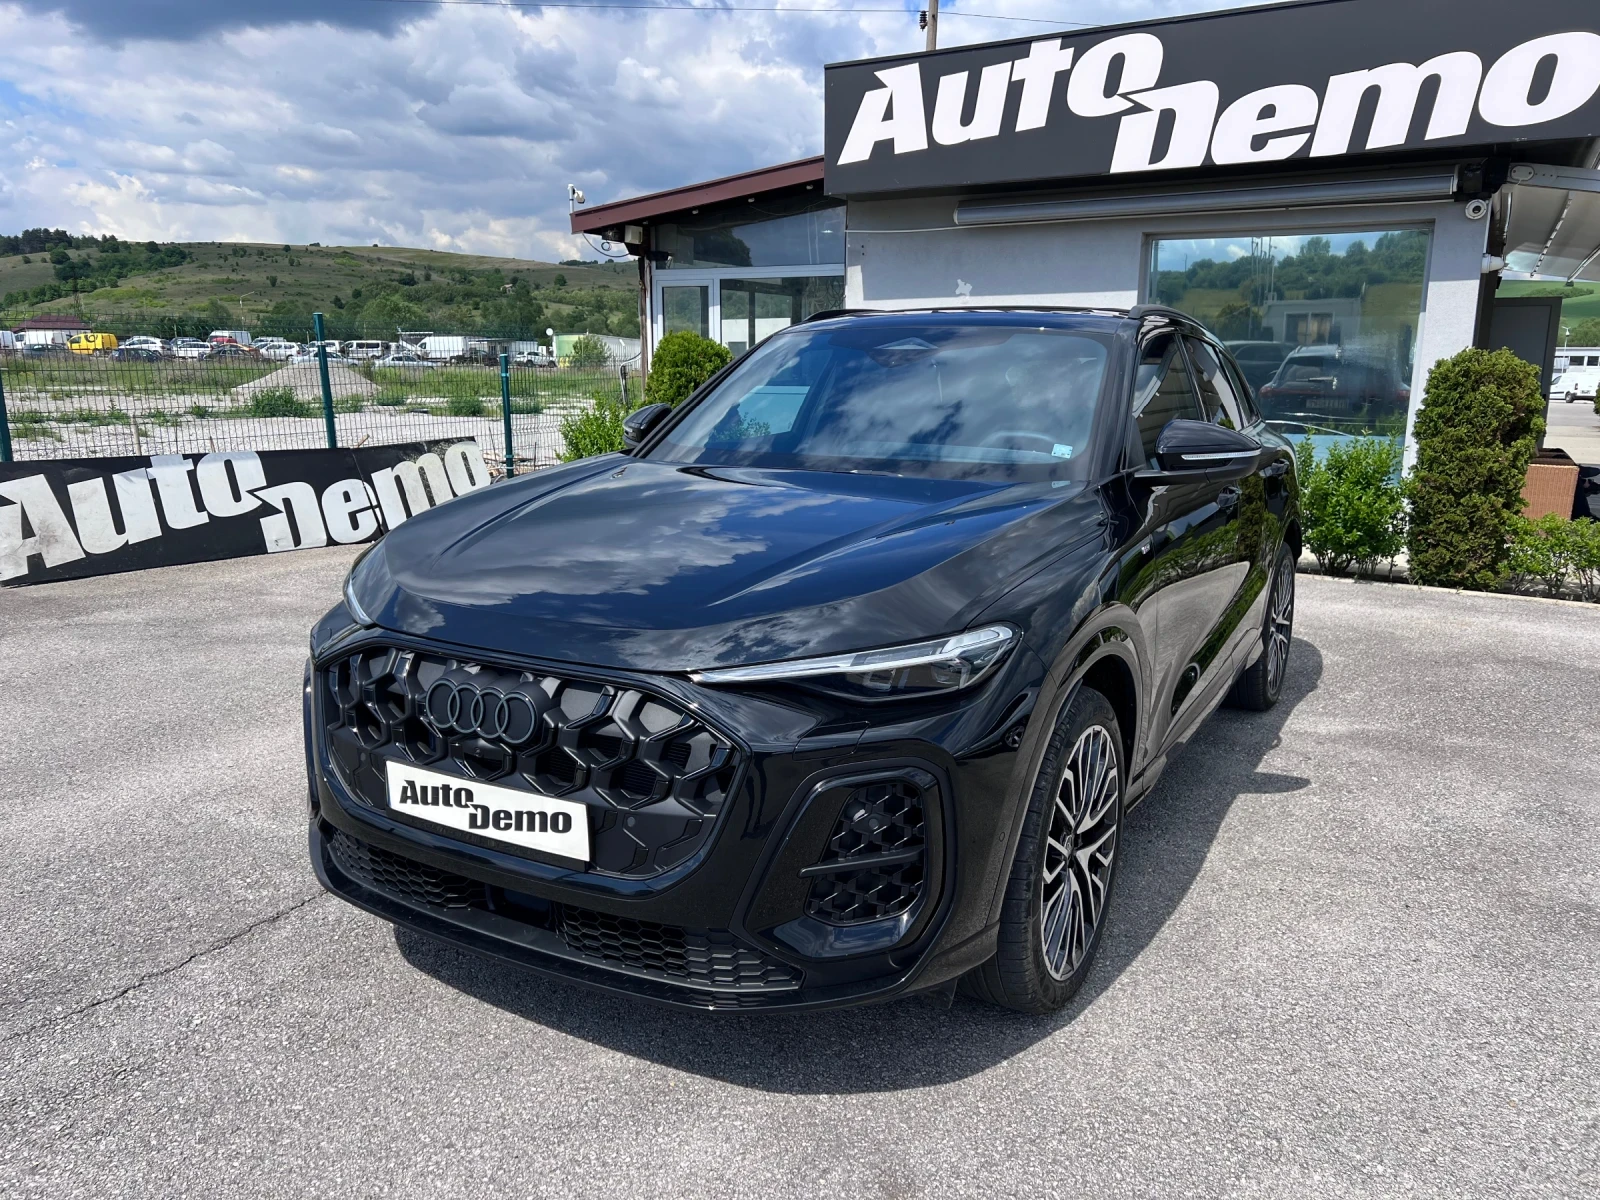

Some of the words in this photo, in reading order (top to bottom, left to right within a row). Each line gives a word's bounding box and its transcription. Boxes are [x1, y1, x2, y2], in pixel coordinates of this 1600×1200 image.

[836, 32, 1164, 166] Auto
[1109, 31, 1600, 174] Demo
[0, 451, 267, 582] Auto
[259, 440, 492, 553] Demo
[400, 780, 474, 808] Auto
[469, 804, 572, 833] Demo
